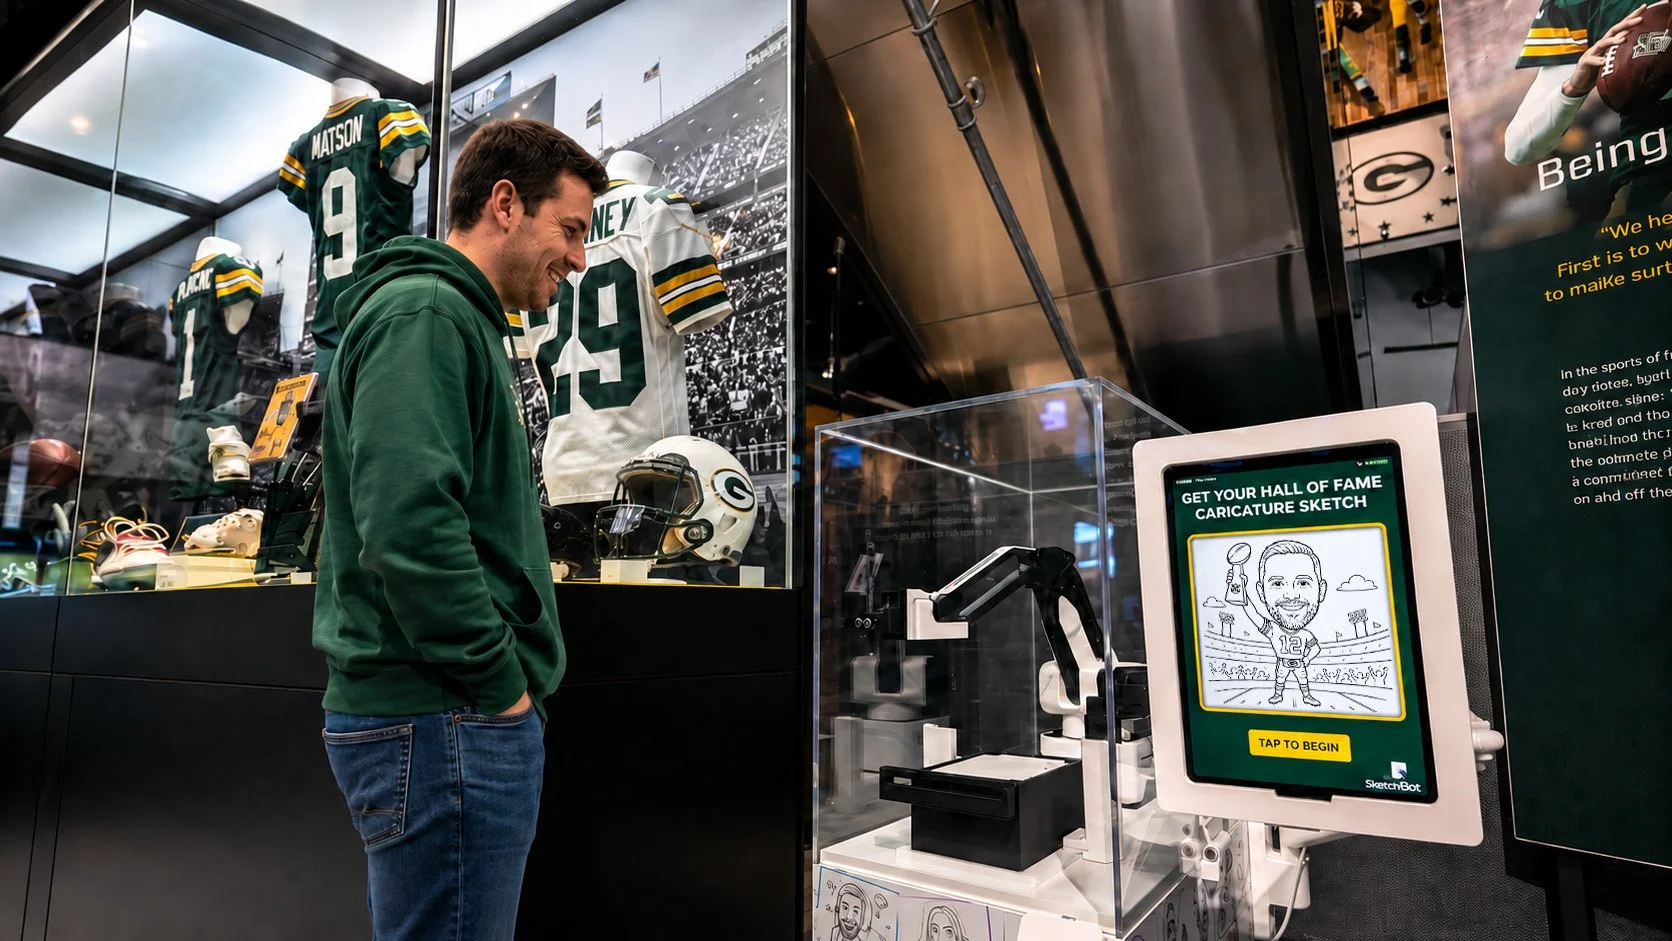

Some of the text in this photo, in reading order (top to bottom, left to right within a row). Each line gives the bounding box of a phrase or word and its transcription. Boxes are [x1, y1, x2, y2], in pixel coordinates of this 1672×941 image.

[312, 114, 364, 161] MATSON
[1537, 127, 1668, 192] Being
[322, 166, 358, 280] 9
[584, 196, 637, 244] NEY
[1557, 254, 1602, 278] First
[1606, 250, 1623, 265] is
[1628, 244, 1650, 258] to
[1544, 289, 1564, 302] to
[529, 258, 647, 419] 29
[178, 307, 196, 401] 1
[1576, 366, 1598, 377] the
[1601, 357, 1642, 373] sports
[1646, 351, 1661, 364] of
[1582, 416, 1613, 431] kred
[1570, 456, 1593, 469] the
[1181, 475, 1382, 504] GET YOUR HALL OF FAME
[1573, 495, 1590, 505] on
[1649, 486, 1672, 499] the
[1195, 495, 1368, 520] CARICATURE SKETCH
[1279, 635, 1302, 655] 12
[1258, 738, 1339, 752] TAP TO BEGIN
[1365, 779, 1422, 793] SketchBot
